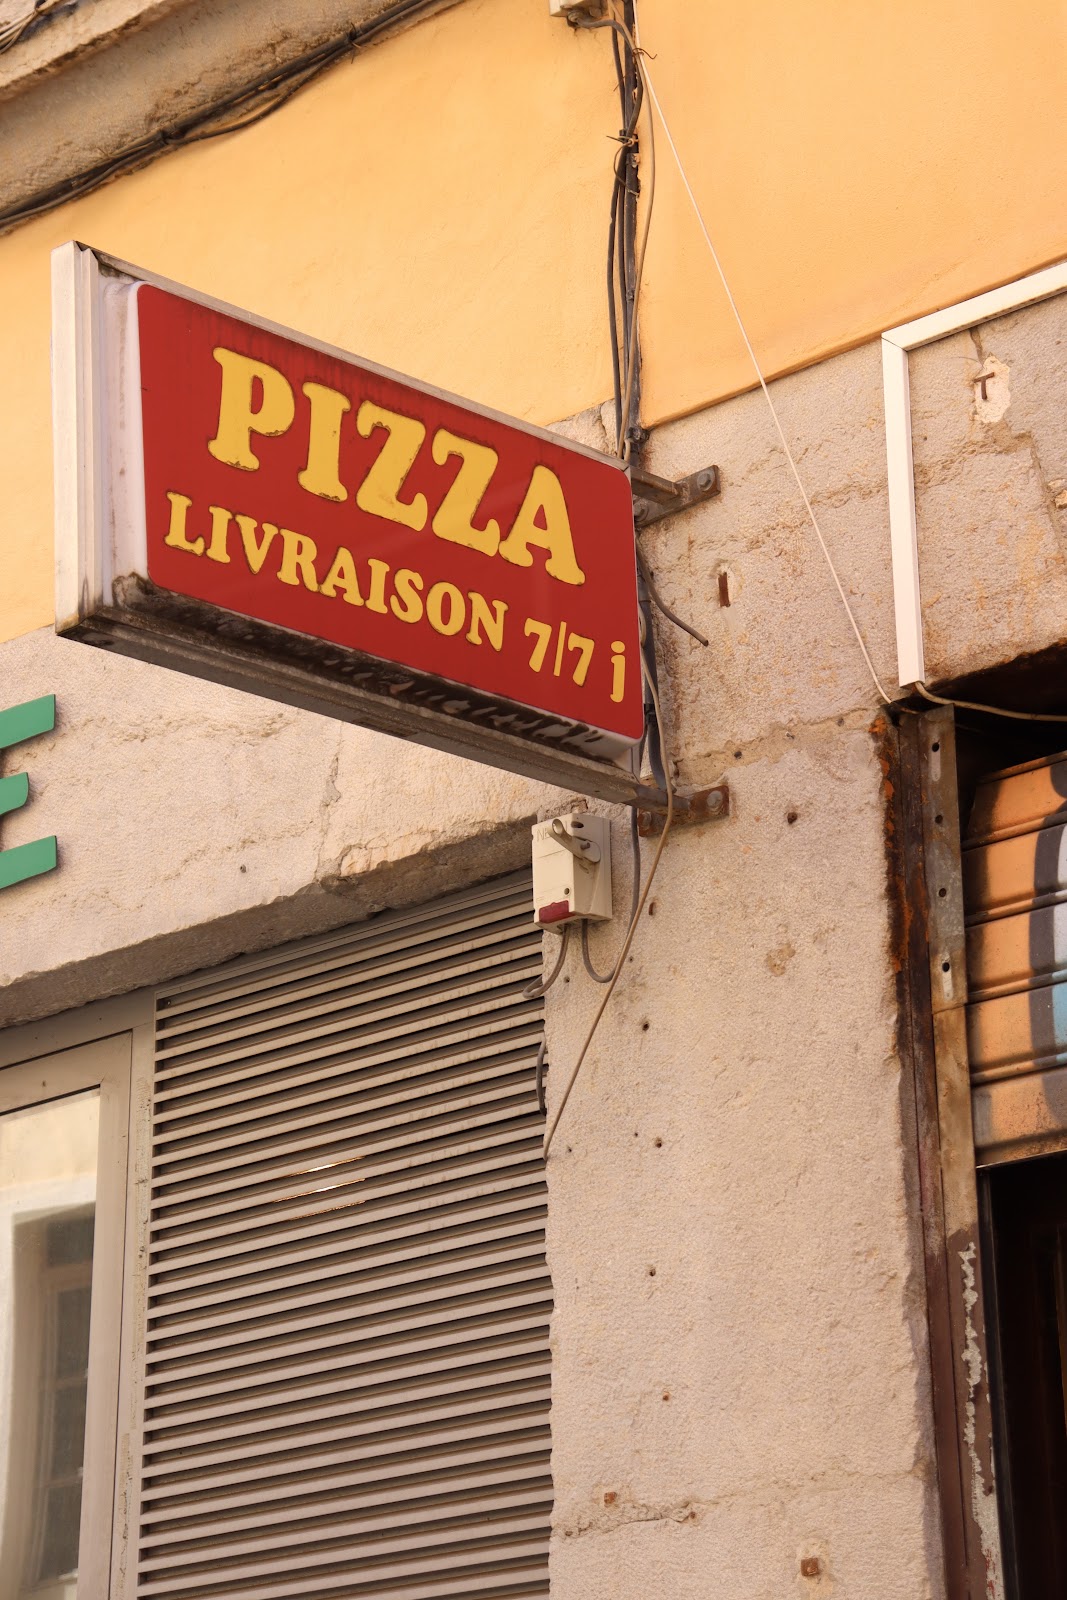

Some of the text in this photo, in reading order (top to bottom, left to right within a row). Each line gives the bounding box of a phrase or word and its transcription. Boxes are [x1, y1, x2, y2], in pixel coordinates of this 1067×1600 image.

[207, 346, 587, 586] PIZZA
[164, 490, 626, 703] LIVRAISON 7/7 j
